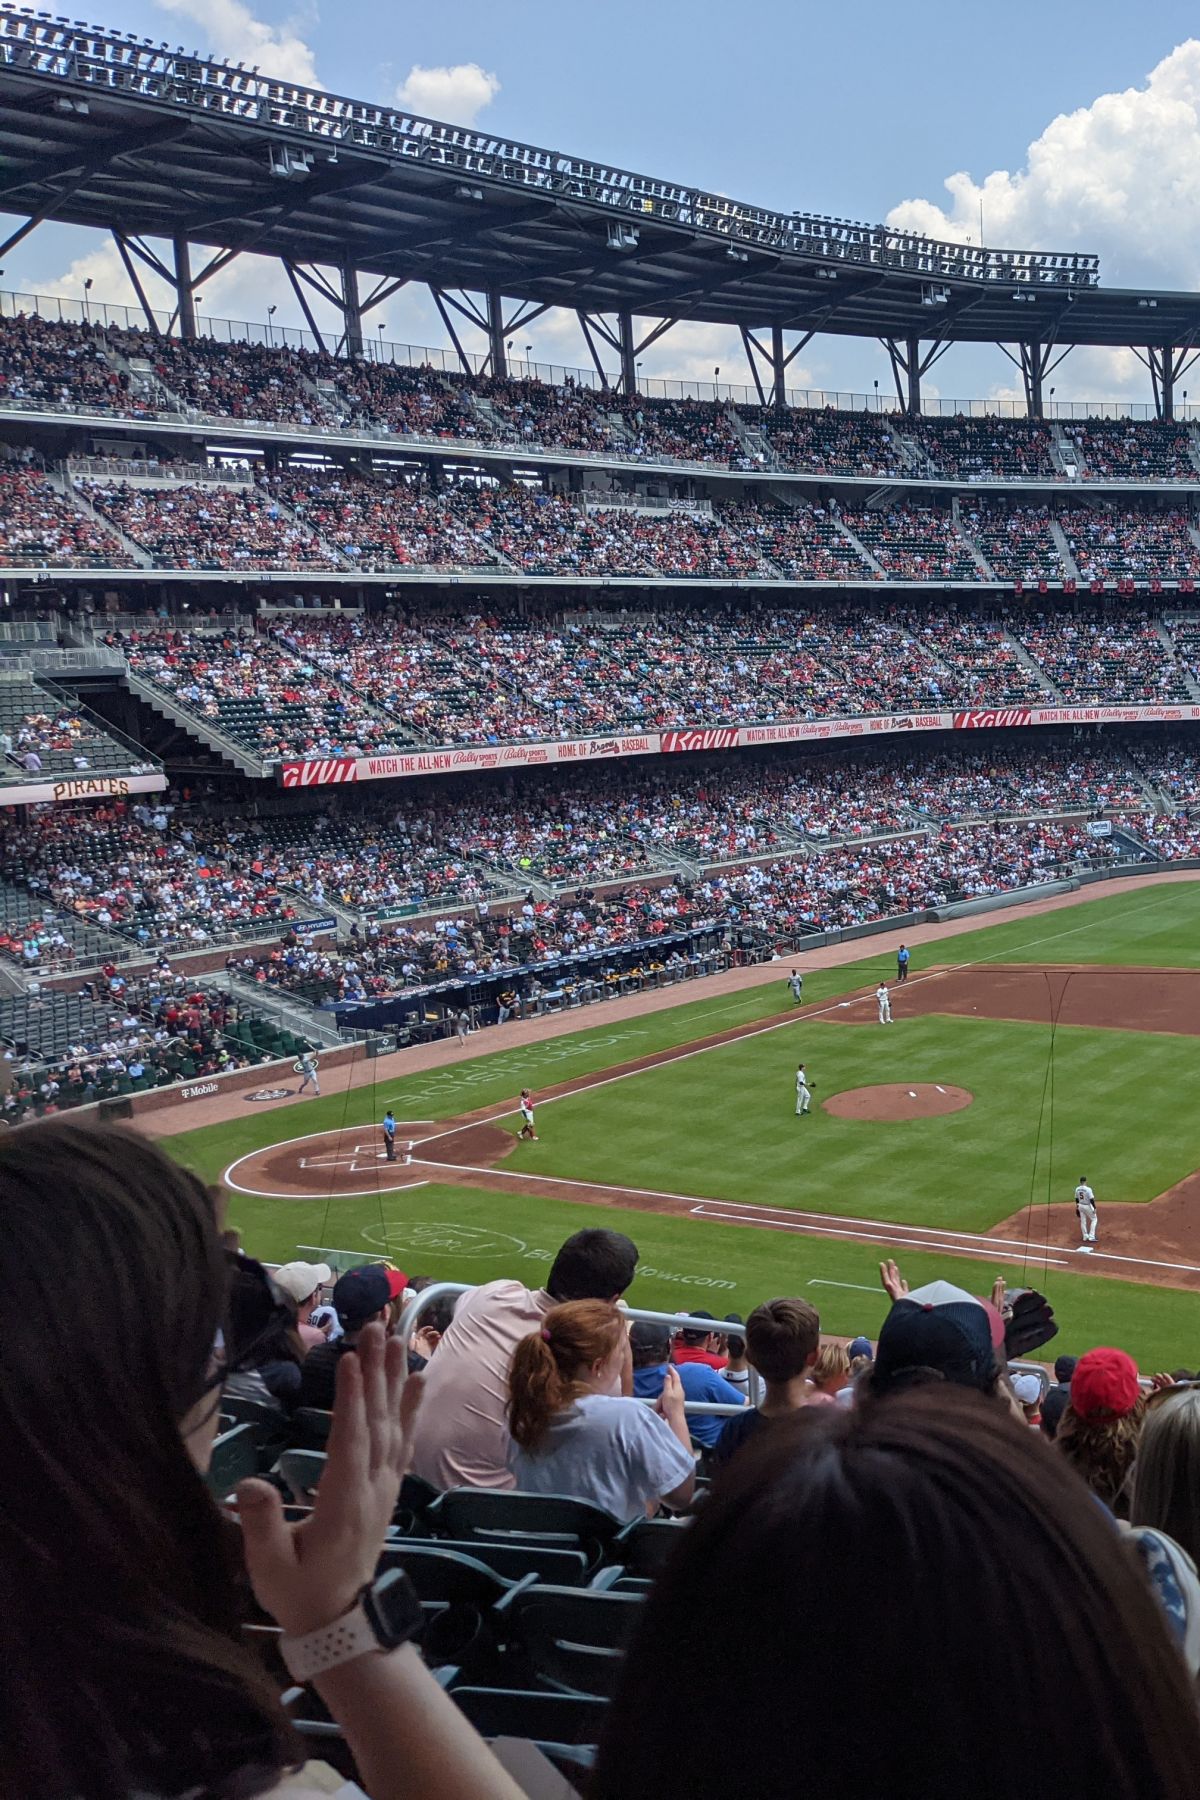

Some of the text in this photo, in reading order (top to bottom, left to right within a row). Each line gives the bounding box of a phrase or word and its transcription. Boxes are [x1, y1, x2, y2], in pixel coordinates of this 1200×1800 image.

[870, 722, 882, 730] HOME
[916, 716, 942, 728] BASEBALL
[1039, 711, 1054, 722] WATCH
[1059, 710, 1070, 720] THE
[1072, 709, 1100, 720] ALL-NEW
[746, 729, 766, 742] WATCH
[766, 728, 776, 740] THE
[778, 726, 800, 738] ALL-NEW
[558, 744, 576, 758] HOME
[578, 743, 586, 756] OF
[590, 739, 620, 756] Braves
[622, 738, 648, 752] BASEBALL
[369, 758, 398, 774] WATCH
[401, 757, 415, 772] THE
[418, 754, 451, 770] ALL-NEW
[453, 752, 478, 765] Bally
[504, 748, 528, 760] Bally
[54, 776, 129, 800] PIRATES
[308, 920, 334, 929] HYUNDAI
[190, 1082, 218, 1096] Mobile
